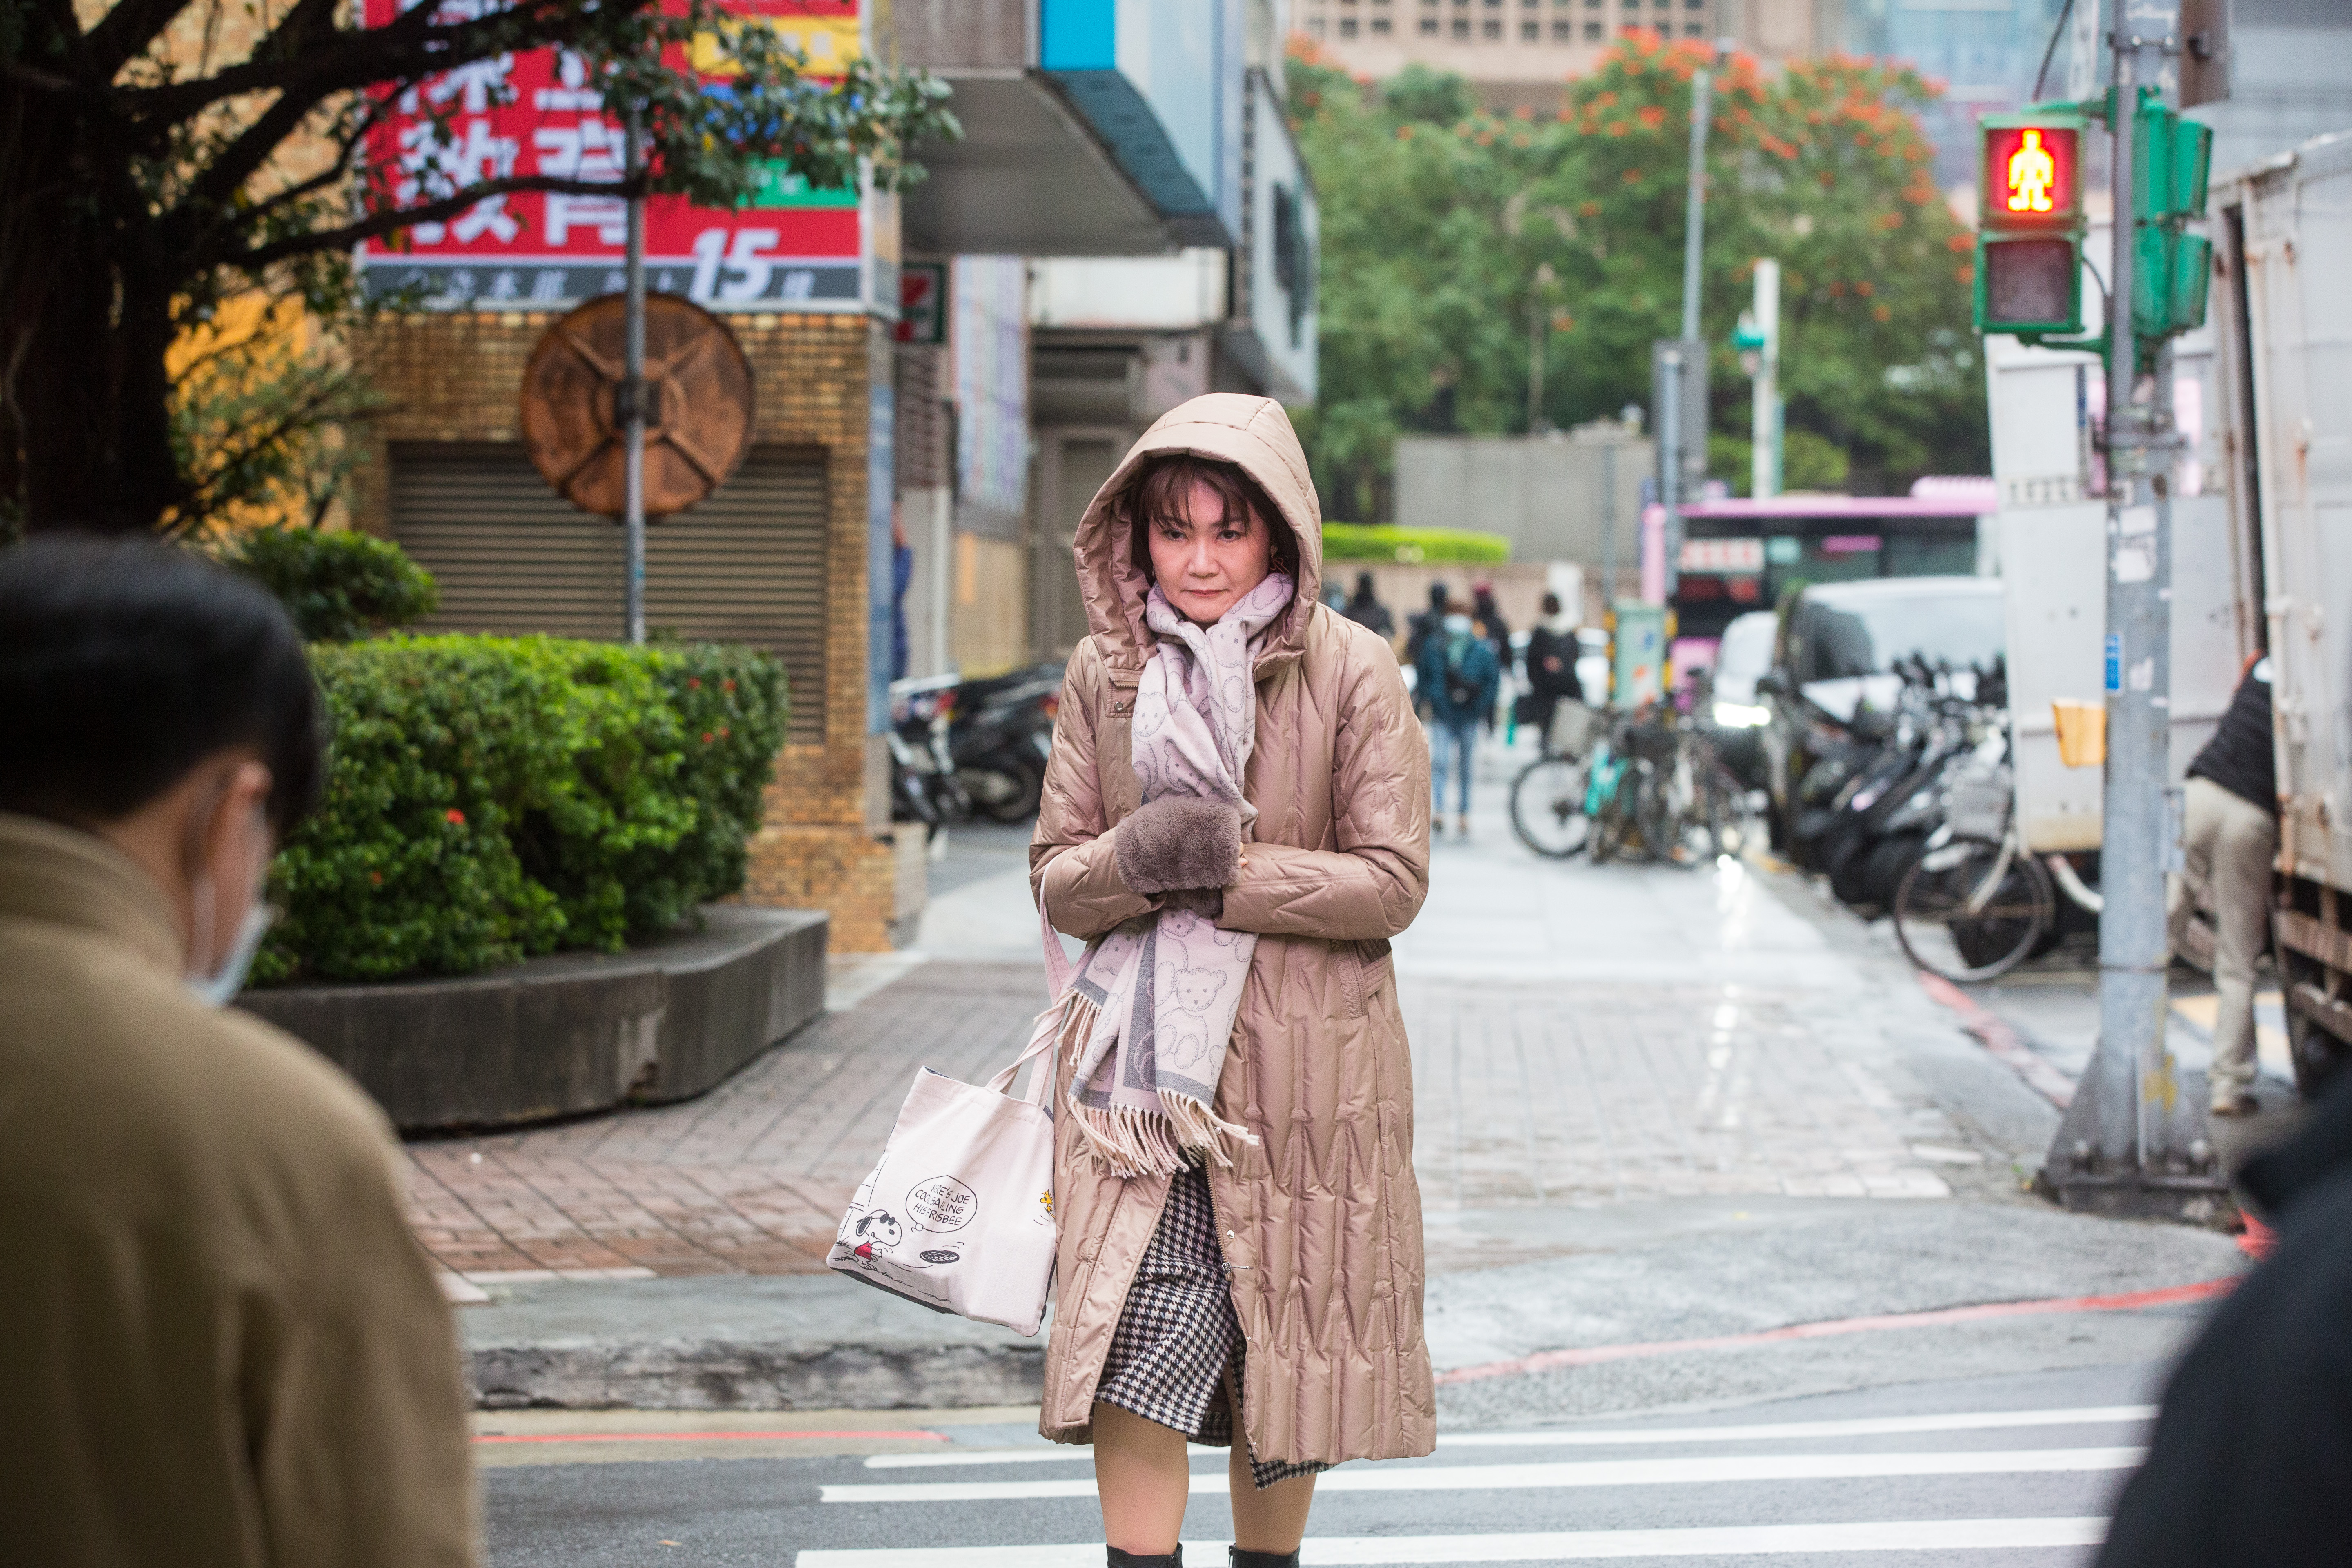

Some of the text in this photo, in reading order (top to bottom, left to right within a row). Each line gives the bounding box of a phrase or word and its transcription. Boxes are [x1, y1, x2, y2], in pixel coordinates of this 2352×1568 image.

[689, 228, 780, 302] 15
[930, 1197, 964, 1214] SAILING
[951, 1193, 970, 1204] JOE
[913, 1203, 962, 1225] HIS FRISBEE
